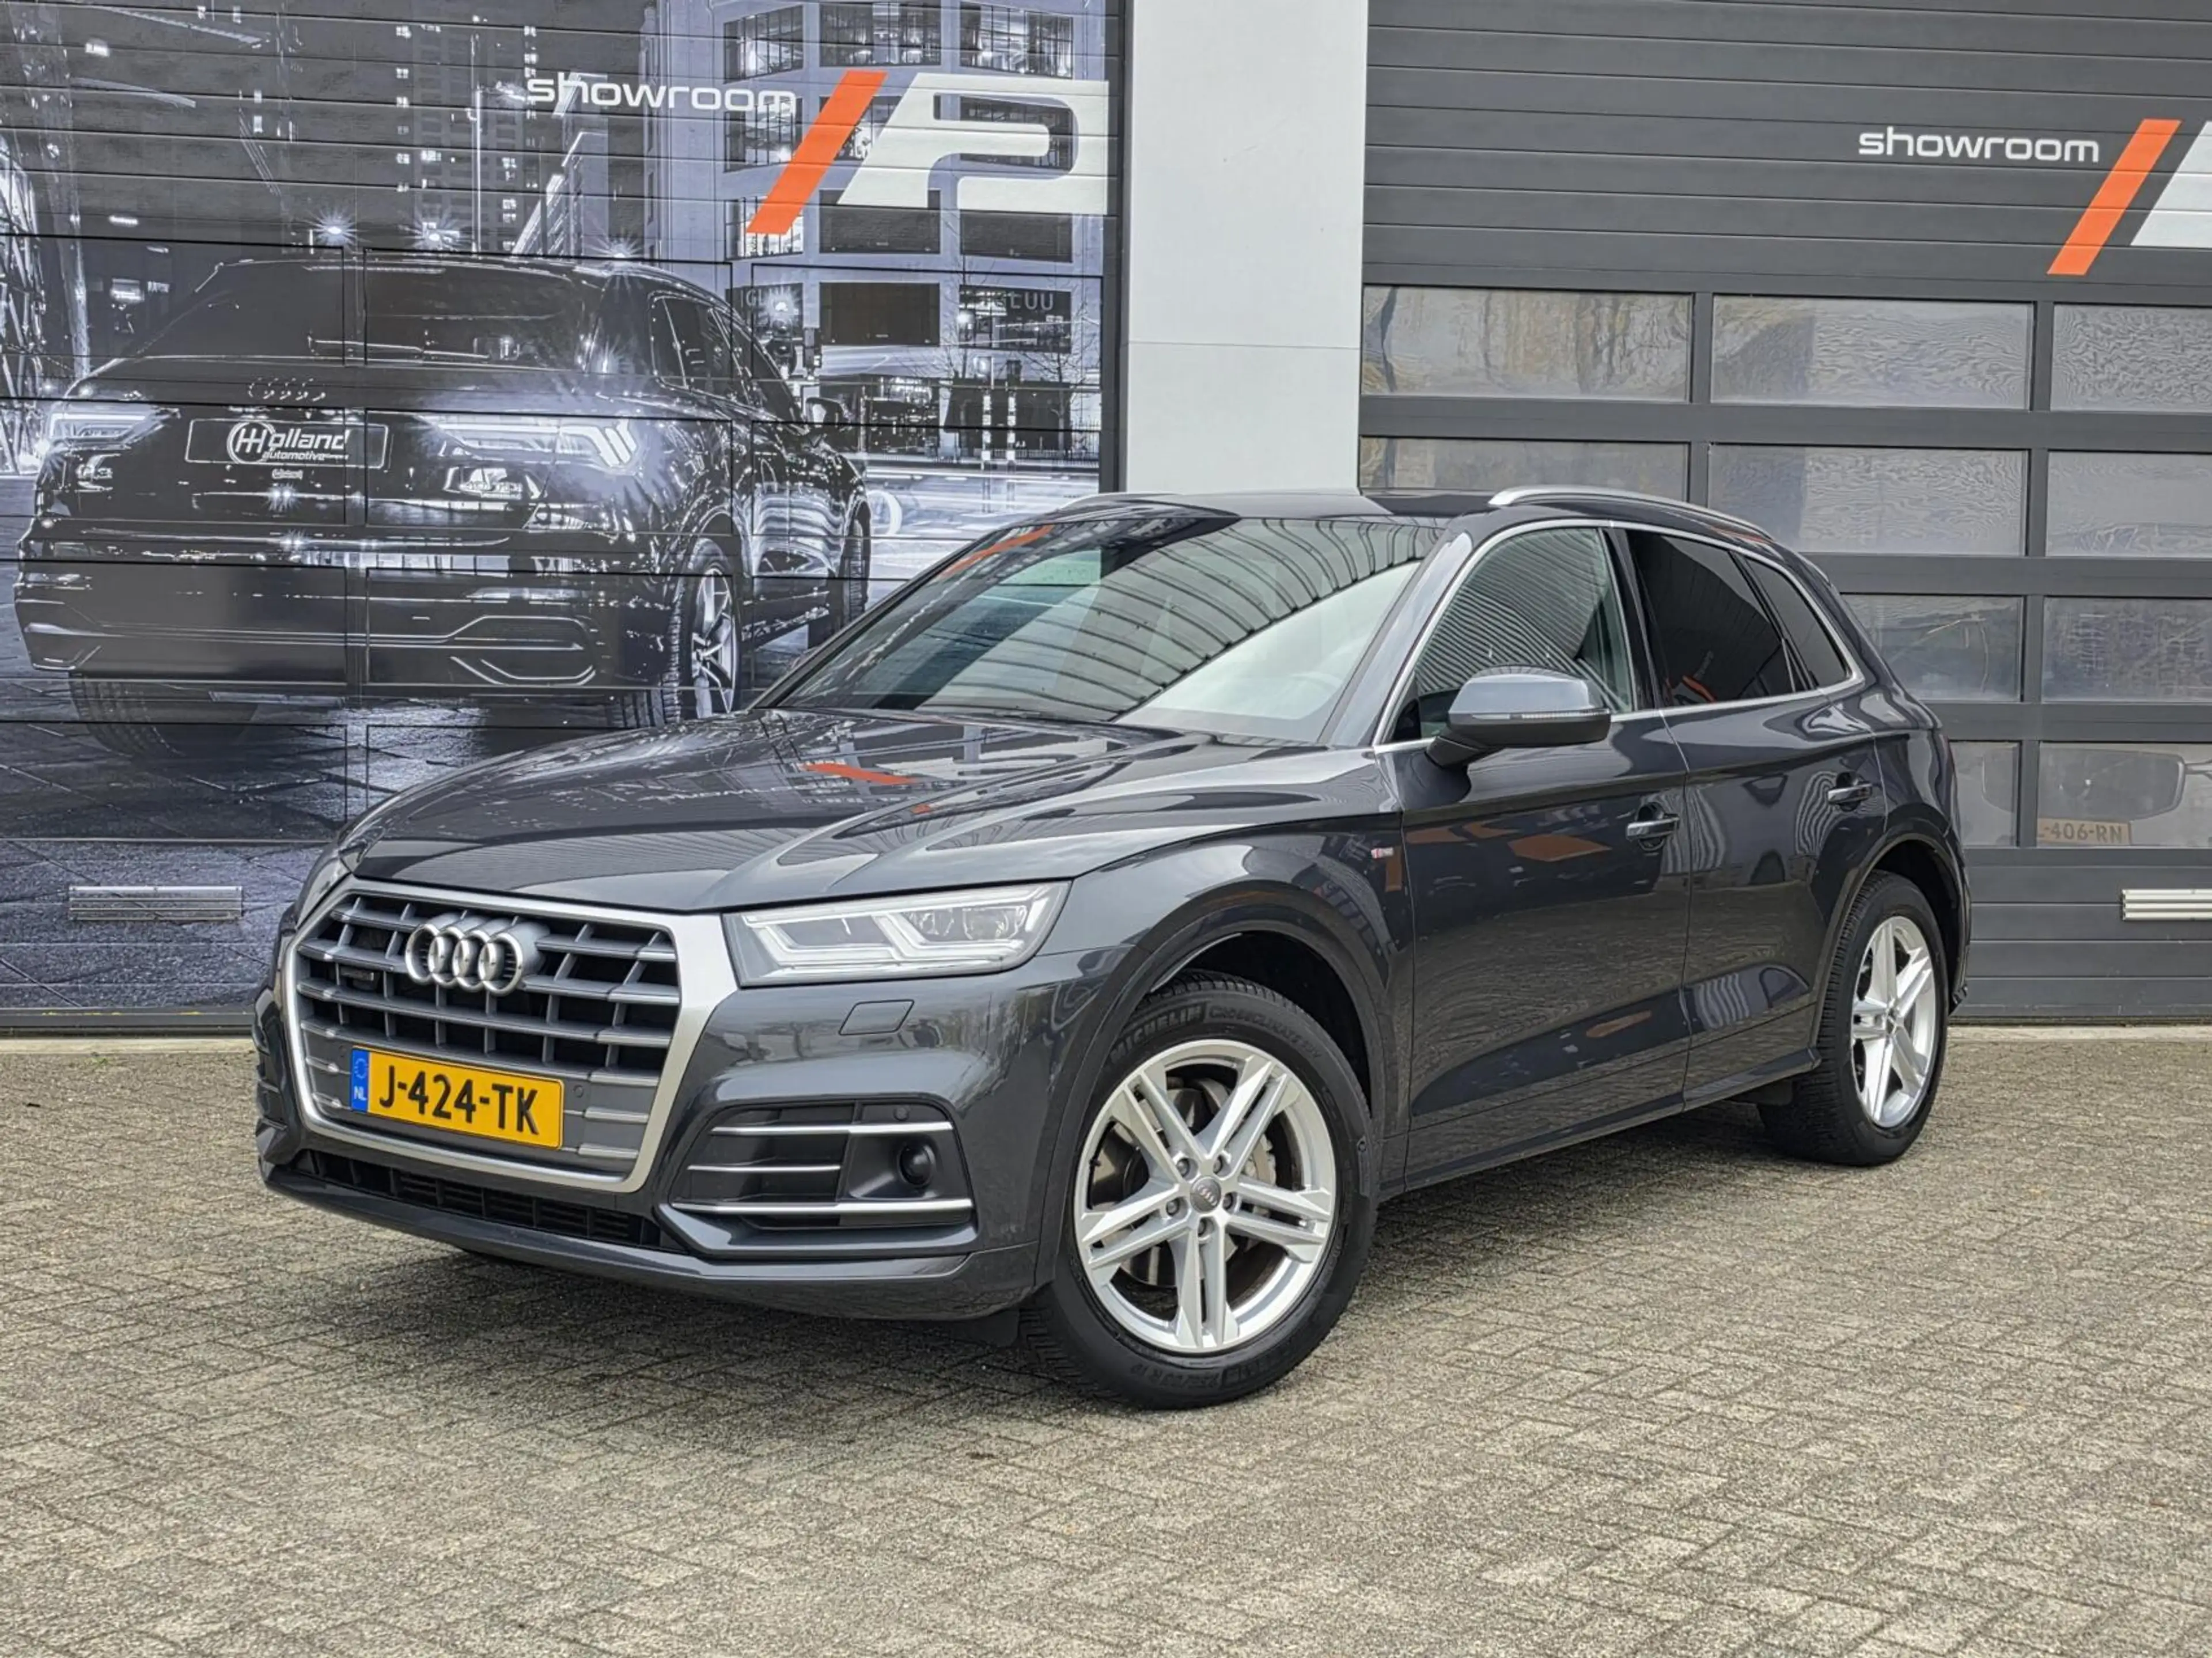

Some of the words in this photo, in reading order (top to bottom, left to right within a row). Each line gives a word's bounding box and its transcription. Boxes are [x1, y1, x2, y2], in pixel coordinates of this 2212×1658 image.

[527, 71, 797, 115] showroom
[1858, 126, 2100, 163] showroom
[262, 450, 325, 461] automotive
[2038, 822, 2123, 844] -406-RN
[1108, 1005, 1205, 1061] MICHELIN
[353, 1086, 368, 1101] NL
[379, 1065, 539, 1136] J-424-TK
